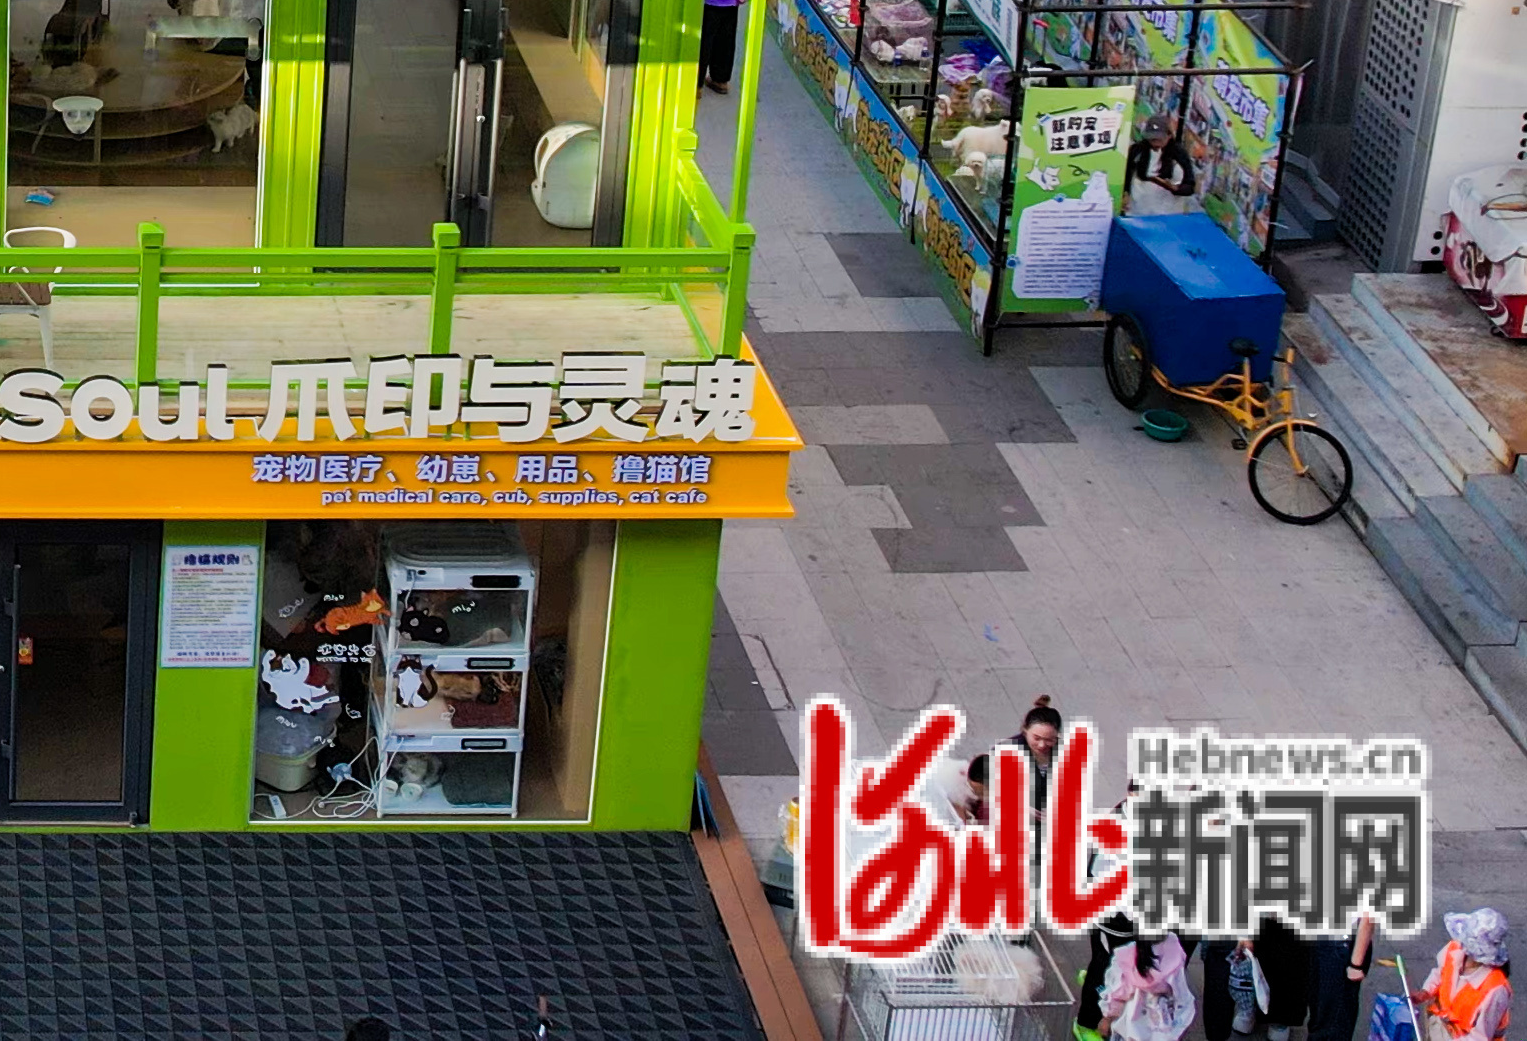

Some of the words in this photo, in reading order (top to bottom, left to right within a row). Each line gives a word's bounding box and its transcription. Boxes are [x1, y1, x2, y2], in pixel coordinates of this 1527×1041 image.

[258, 351, 757, 444] 爪印与灵魂
[321, 489, 352, 505] pet
[358, 489, 433, 504] medical
[439, 489, 488, 505] care,
[493, 489, 534, 505] cub,
[538, 489, 625, 505] supplies,
[630, 489, 660, 504] cat
[665, 489, 707, 504] cafe
